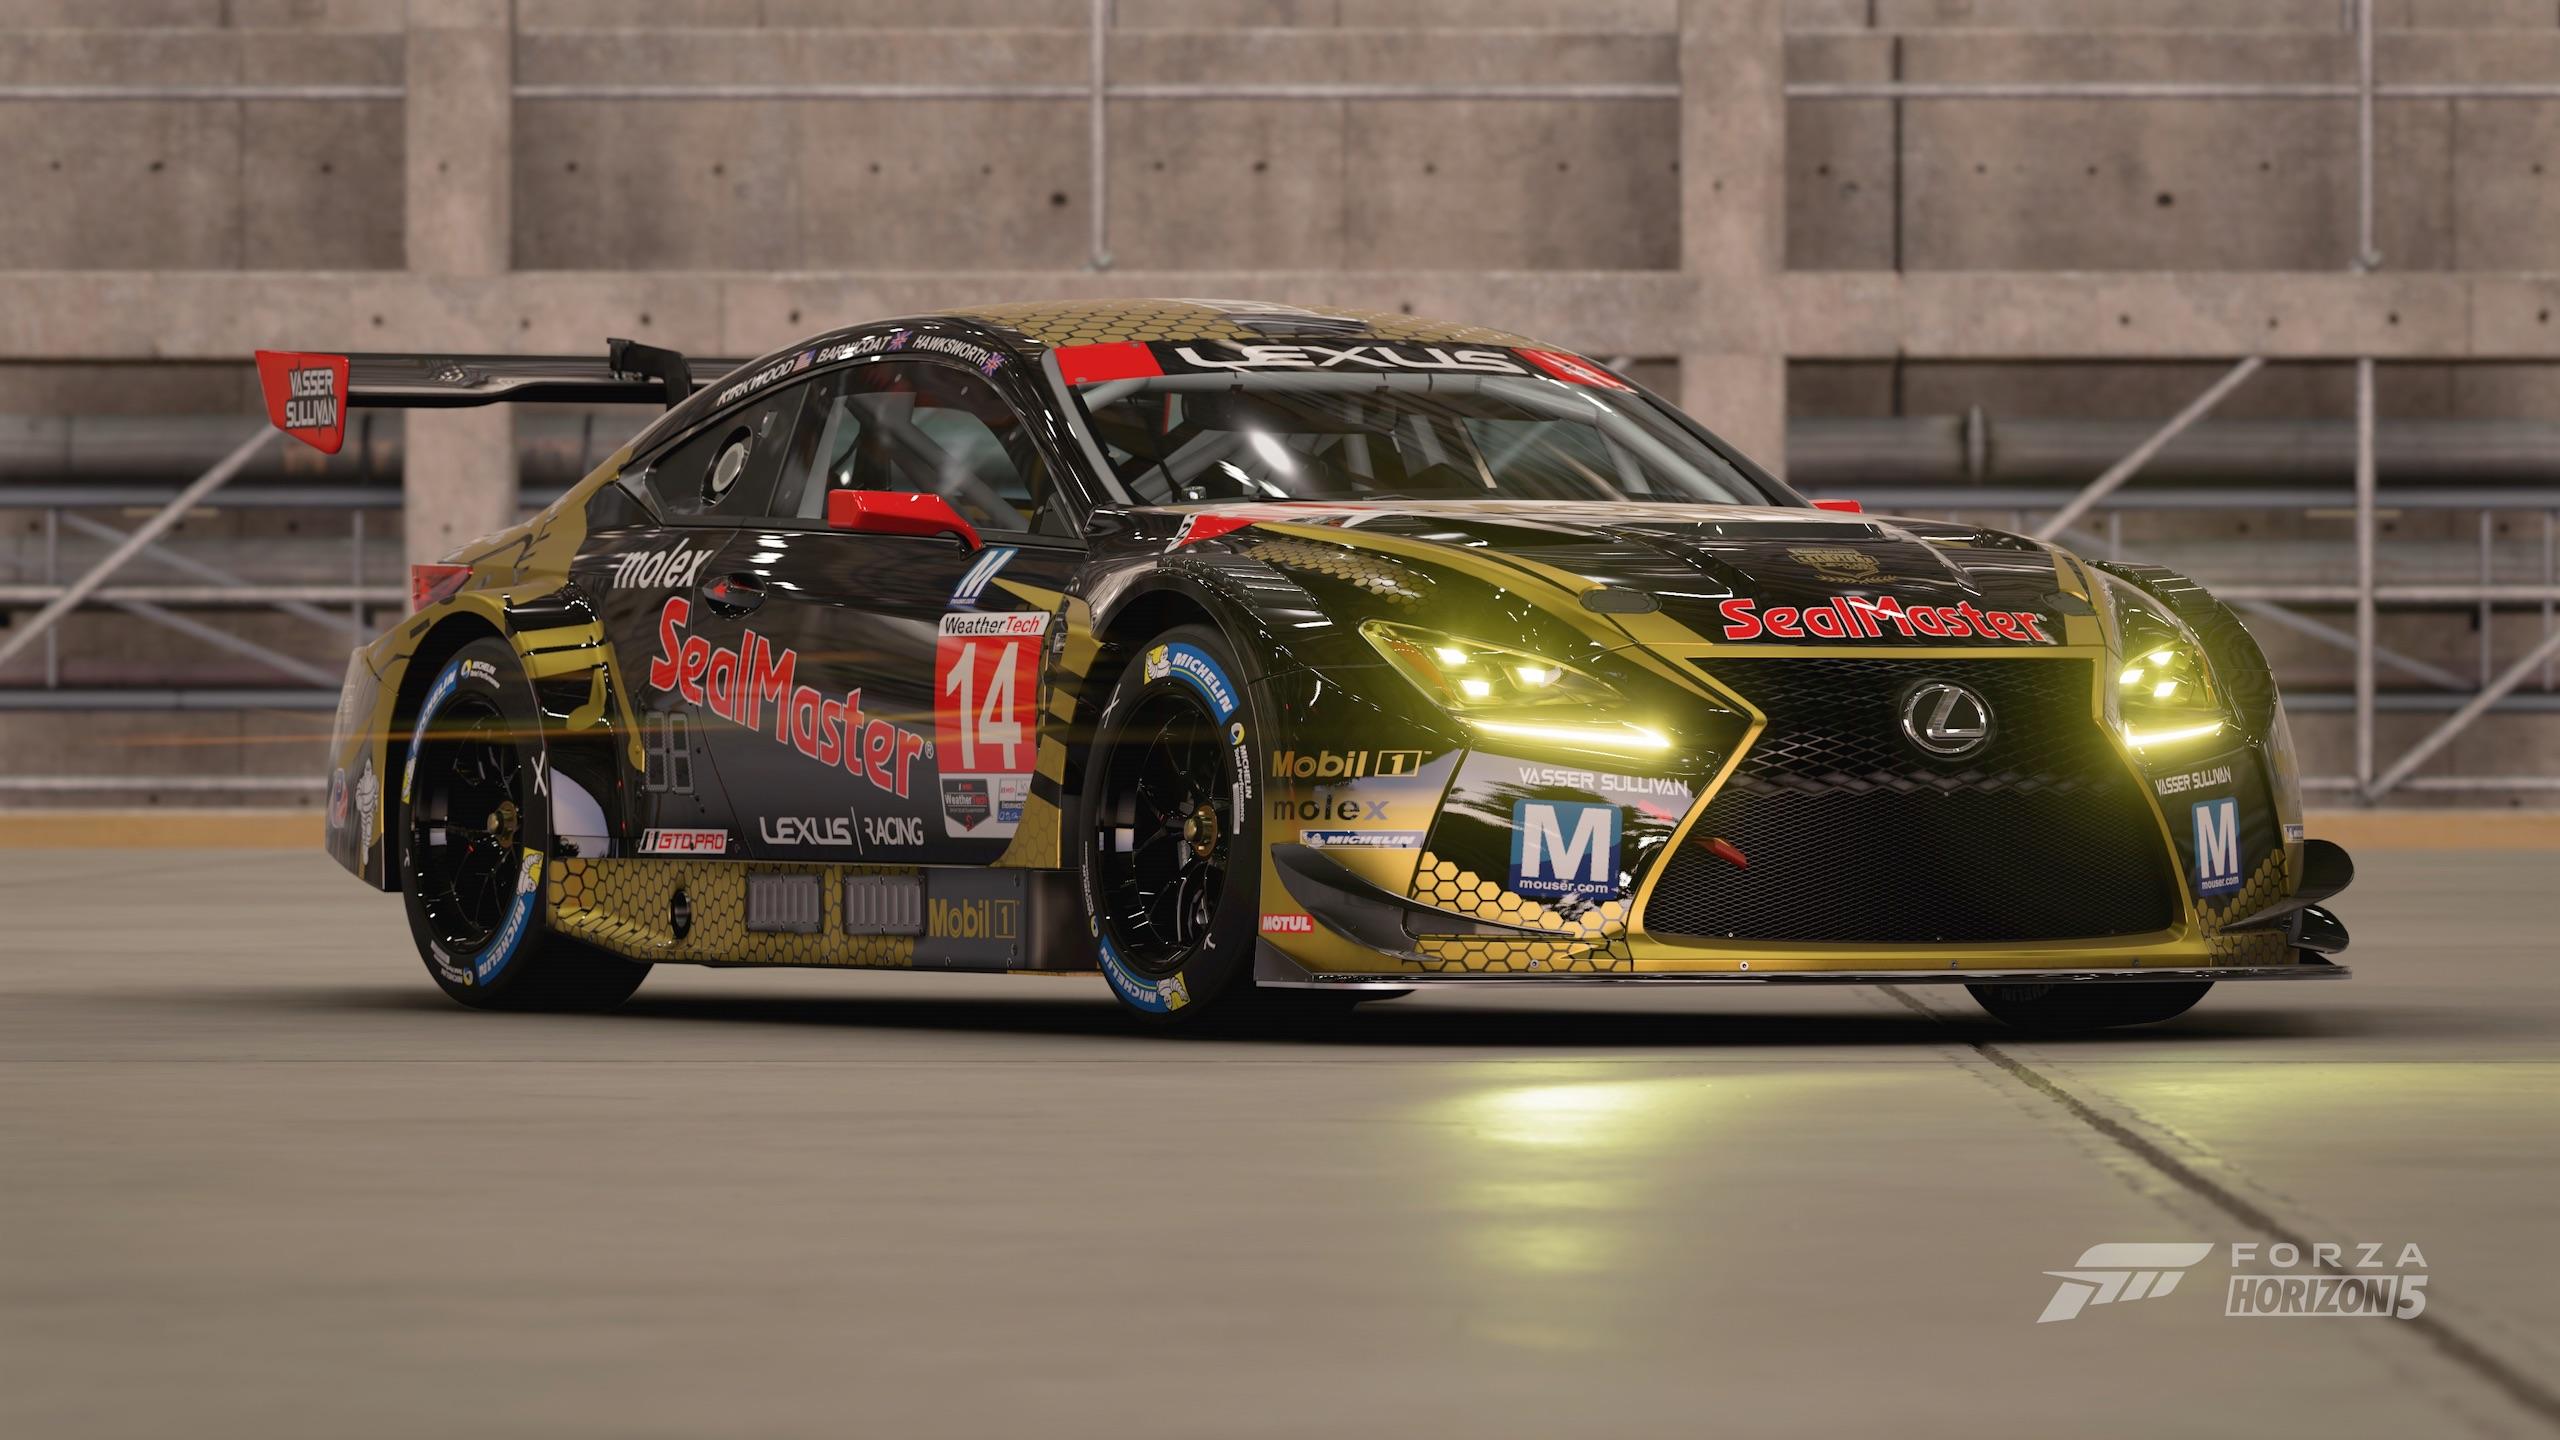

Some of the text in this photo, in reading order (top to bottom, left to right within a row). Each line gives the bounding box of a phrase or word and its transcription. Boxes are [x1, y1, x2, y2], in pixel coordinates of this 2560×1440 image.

[911, 334, 991, 366] HAWKSWORTH
[1175, 344, 1530, 375] LEXUS
[289, 368, 334, 398] VASSER
[716, 359, 795, 407] KIRKWOOD
[286, 397, 337, 428] SULLIVAN
[612, 538, 713, 590] molex
[953, 550, 1015, 598] M
[945, 616, 1040, 635] WeatherTech
[1171, 652, 1233, 713] MICHELIN
[945, 641, 1023, 770] 14
[1240, 744, 1252, 799] MICHELIN
[1272, 750, 1368, 778] Mobil
[1518, 767, 1688, 798] VASSER SULLIVAN
[2155, 765, 2232, 796] VASSER SULLIVAN
[1273, 794, 1389, 821] molex
[658, 833, 693, 849] GTD
[759, 816, 925, 846] LEXUS RACING
[1325, 835, 1416, 845] MICHELIN
[1520, 803, 1612, 882] M
[2196, 802, 2238, 879] M
[1519, 879, 1608, 894] mouser.com
[2201, 876, 2239, 890] mouser.com
[928, 898, 990, 938] Mobil
[1262, 915, 1312, 932] MOTUL
[478, 898, 526, 978] MICHELIN
[1100, 946, 1157, 1004] MICHELIN
